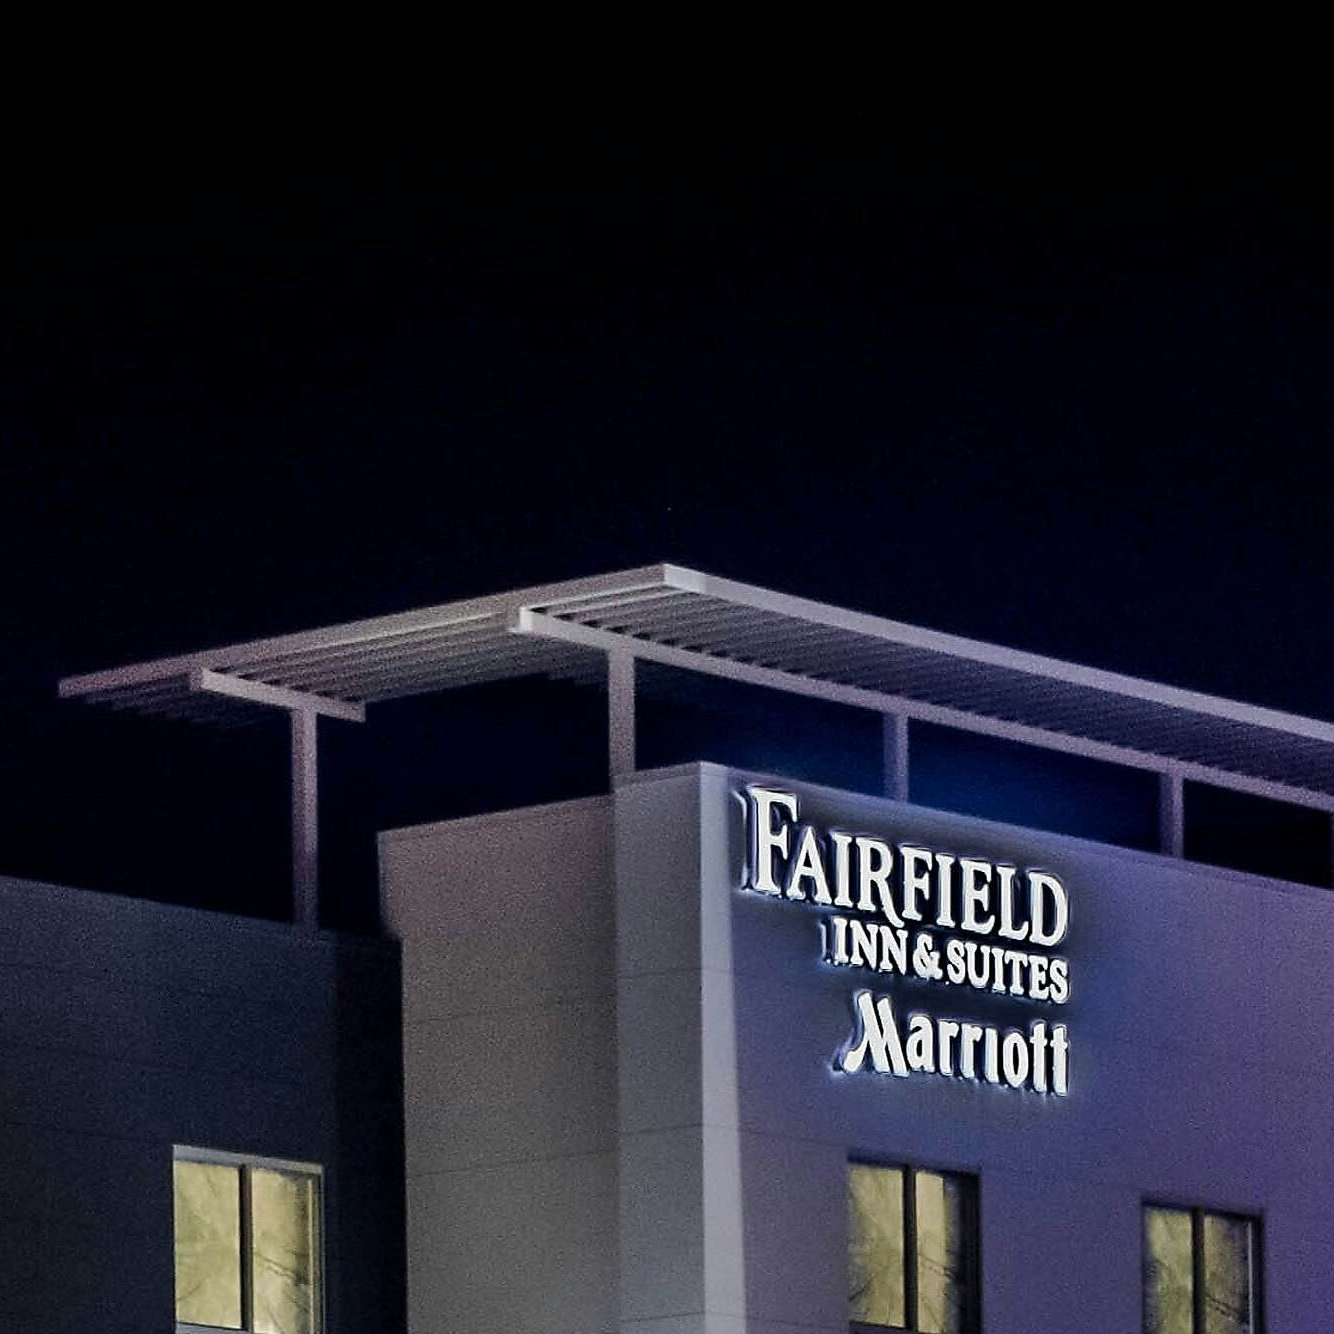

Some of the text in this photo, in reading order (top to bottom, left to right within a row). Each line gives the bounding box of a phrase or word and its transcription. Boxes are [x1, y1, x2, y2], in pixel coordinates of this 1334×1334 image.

[748, 786, 1068, 946] FAIRFIELD
[830, 918, 1069, 1005] INN & SUITES
[842, 991, 1068, 1096] Marriott
